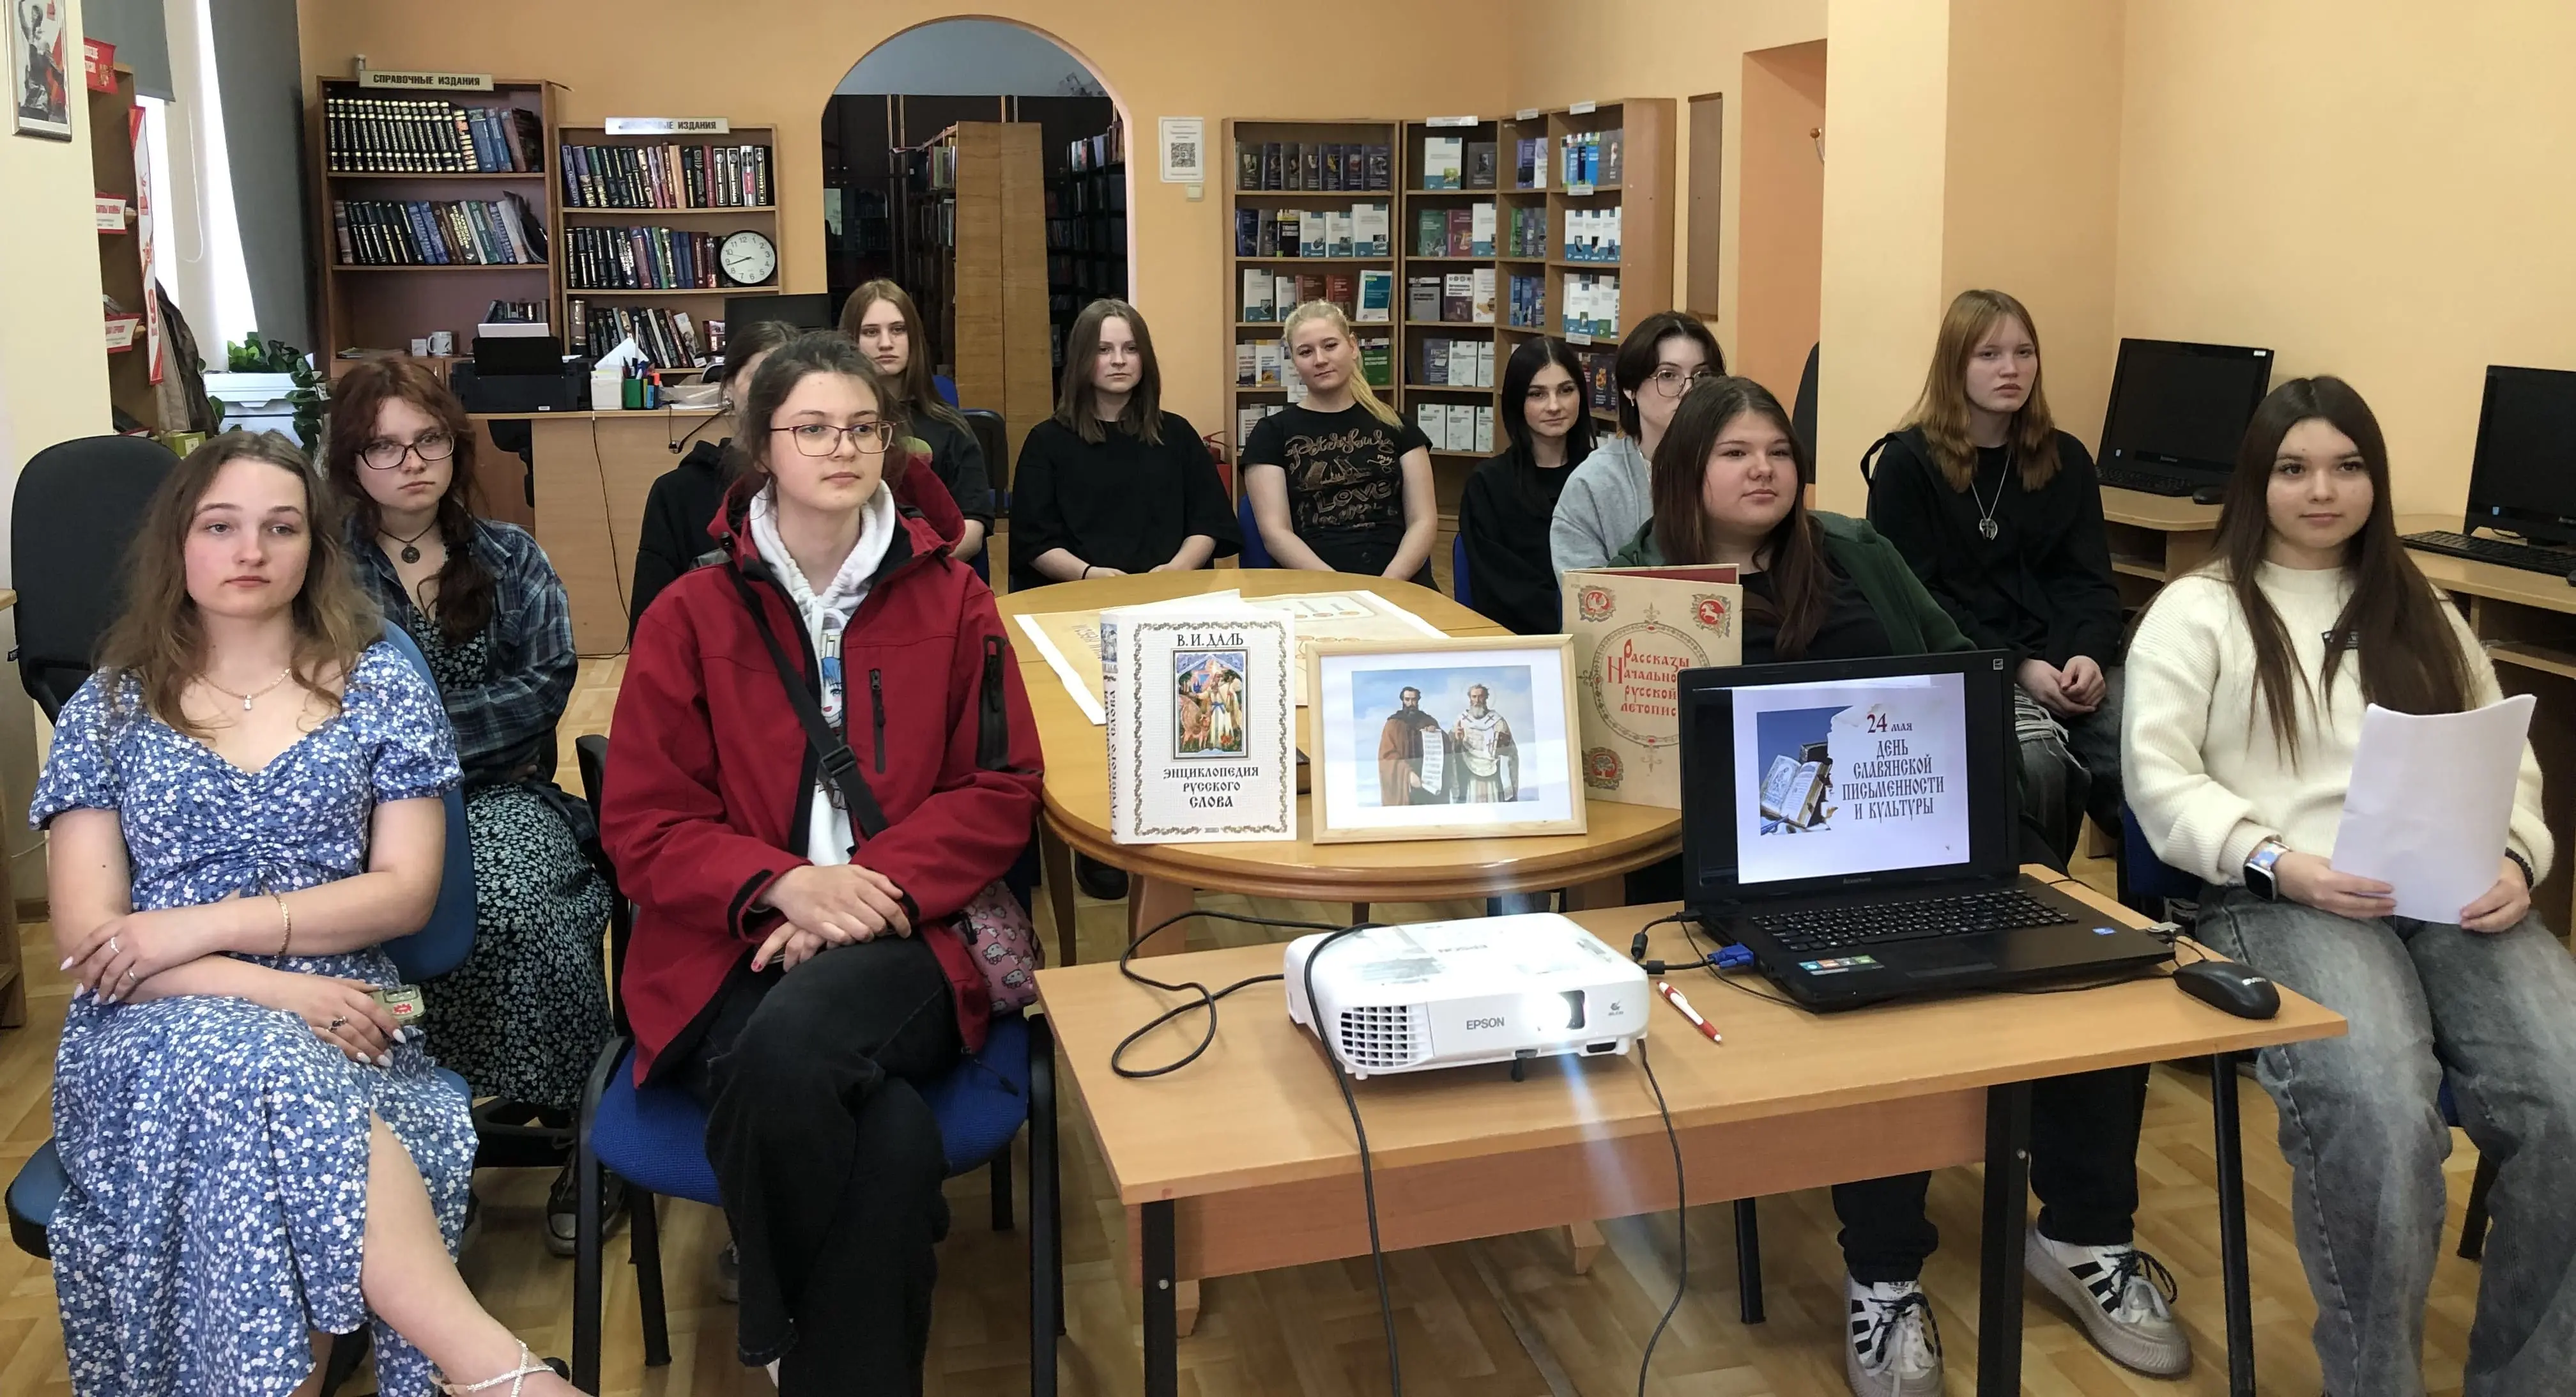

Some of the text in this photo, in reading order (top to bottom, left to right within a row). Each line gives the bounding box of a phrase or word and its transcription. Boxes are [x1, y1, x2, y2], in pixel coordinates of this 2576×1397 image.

[373, 73, 480, 86] СПРАВОЧНЫЕ ИЗДАНИЯ
[677, 121, 717, 130] ИЗДАНИЯ
[148, 289, 157, 324] 9
[1620, 704, 1676, 717] летопис
[1866, 713, 1888, 734] 24
[1876, 738, 1909, 760] ДЕНЬ
[1163, 766, 1259, 780] ЭНЦИКЛОПЕДИЯ
[1853, 753, 1933, 780] СЛАВЯНСКОЙ
[1183, 781, 1241, 794] РУССКОГО
[1842, 776, 1945, 801] ПИСЬМЕННОСТИ
[1189, 796, 1234, 808] СЛОВА
[1854, 797, 1935, 824] И КУЛЬТУРЫ
[1466, 1016, 1505, 1031] EPSON
